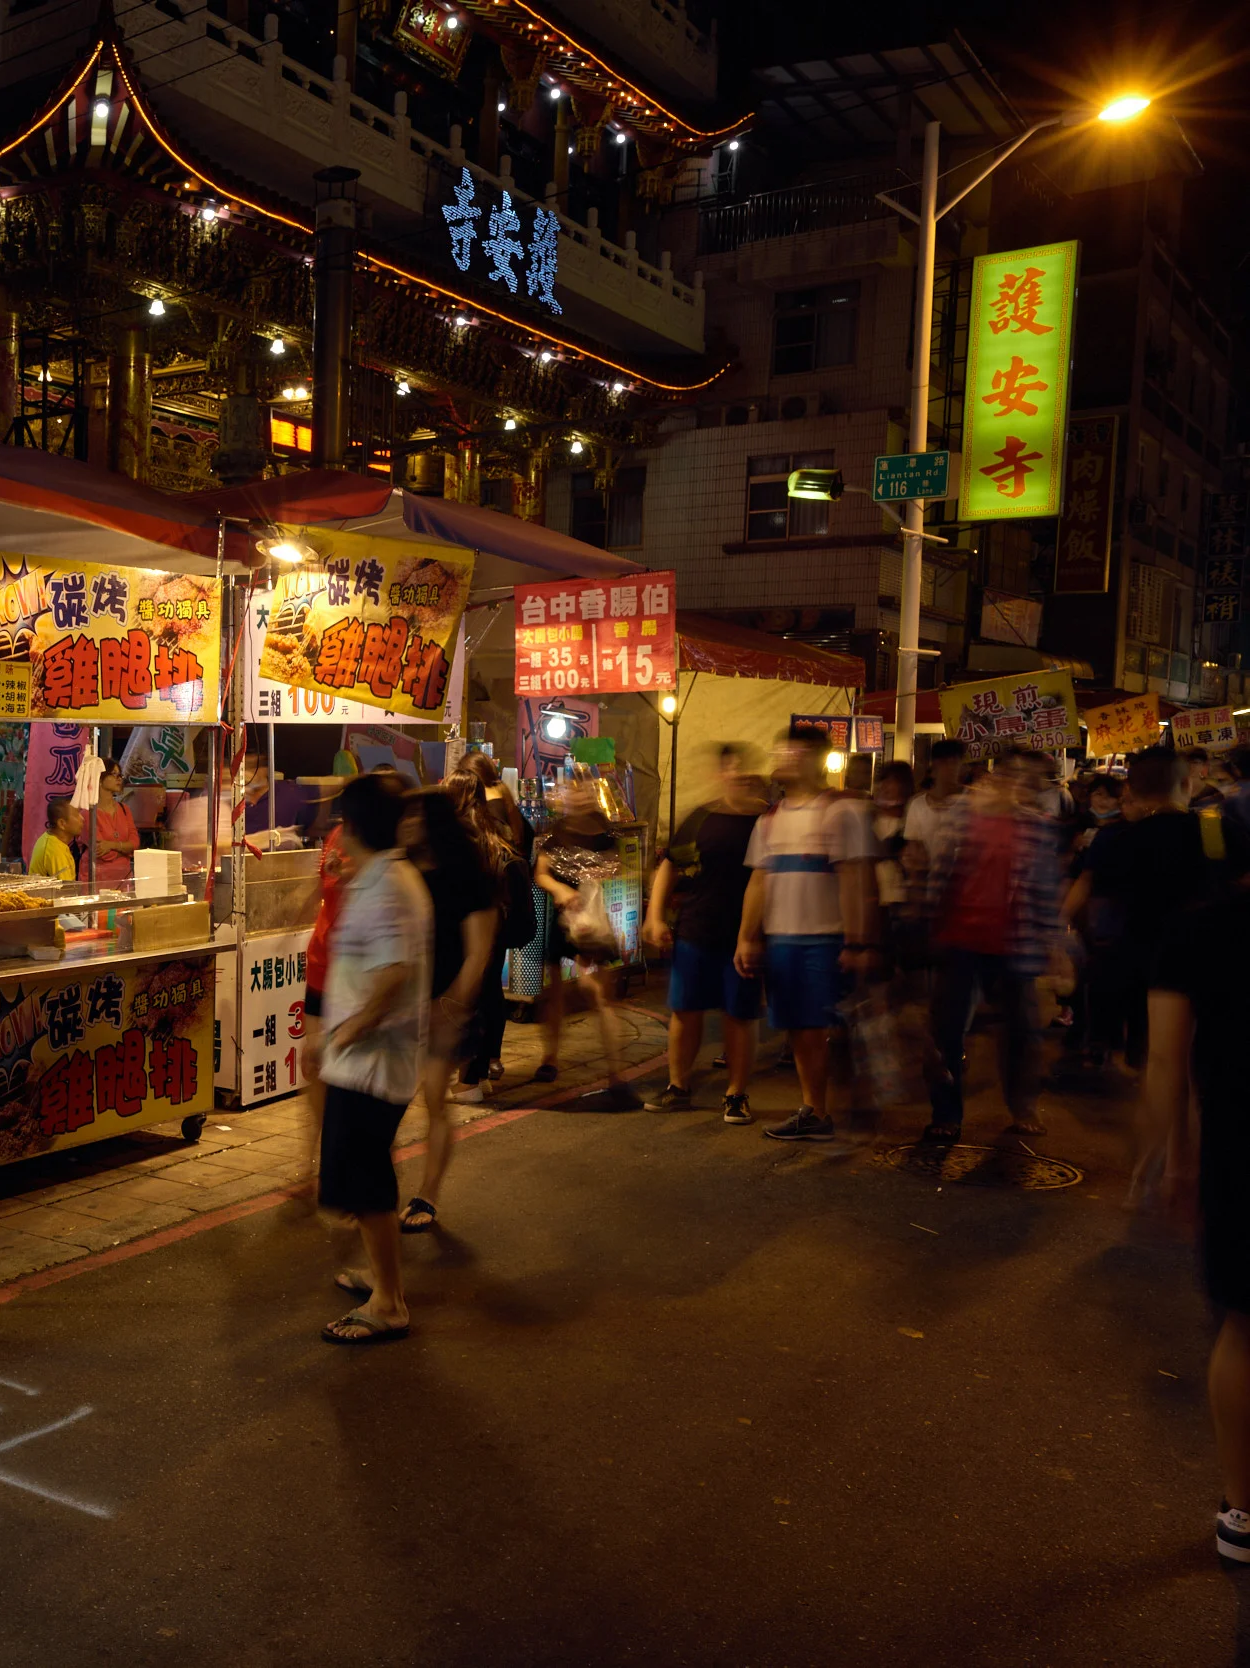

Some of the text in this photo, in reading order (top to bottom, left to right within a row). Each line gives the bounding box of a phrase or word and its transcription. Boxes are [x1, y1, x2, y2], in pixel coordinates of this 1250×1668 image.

[979, 267, 1055, 499] 護安寺
[879, 471, 921, 480] Liantan
[890, 480, 907, 496] 116
[50, 571, 130, 631] 碳烤
[327, 558, 385, 608] 碳烤
[138, 598, 211, 622] 醬功獨具
[521, 584, 669, 625] 台中香腸伯
[523, 625, 583, 645] 大腸包小腸
[614, 620, 657, 639] 香腸
[42, 629, 204, 711] 雞腿排
[313, 616, 450, 710] 雞腿排
[519, 647, 589, 669] 一組 35 元
[616, 645, 672, 686] 15 元
[258, 690, 281, 717] 三組
[972, 684, 1042, 715] 現煎
[1177, 727, 1233, 748] 仙草凍
[46, 973, 125, 1052] 碳烤
[133, 978, 205, 1017] 醬功獨具
[253, 1014, 276, 1047] 一組
[288, 1000, 307, 1040] 3
[38, 1027, 199, 1136] 雞腿排
[253, 1060, 277, 1096] 三組
